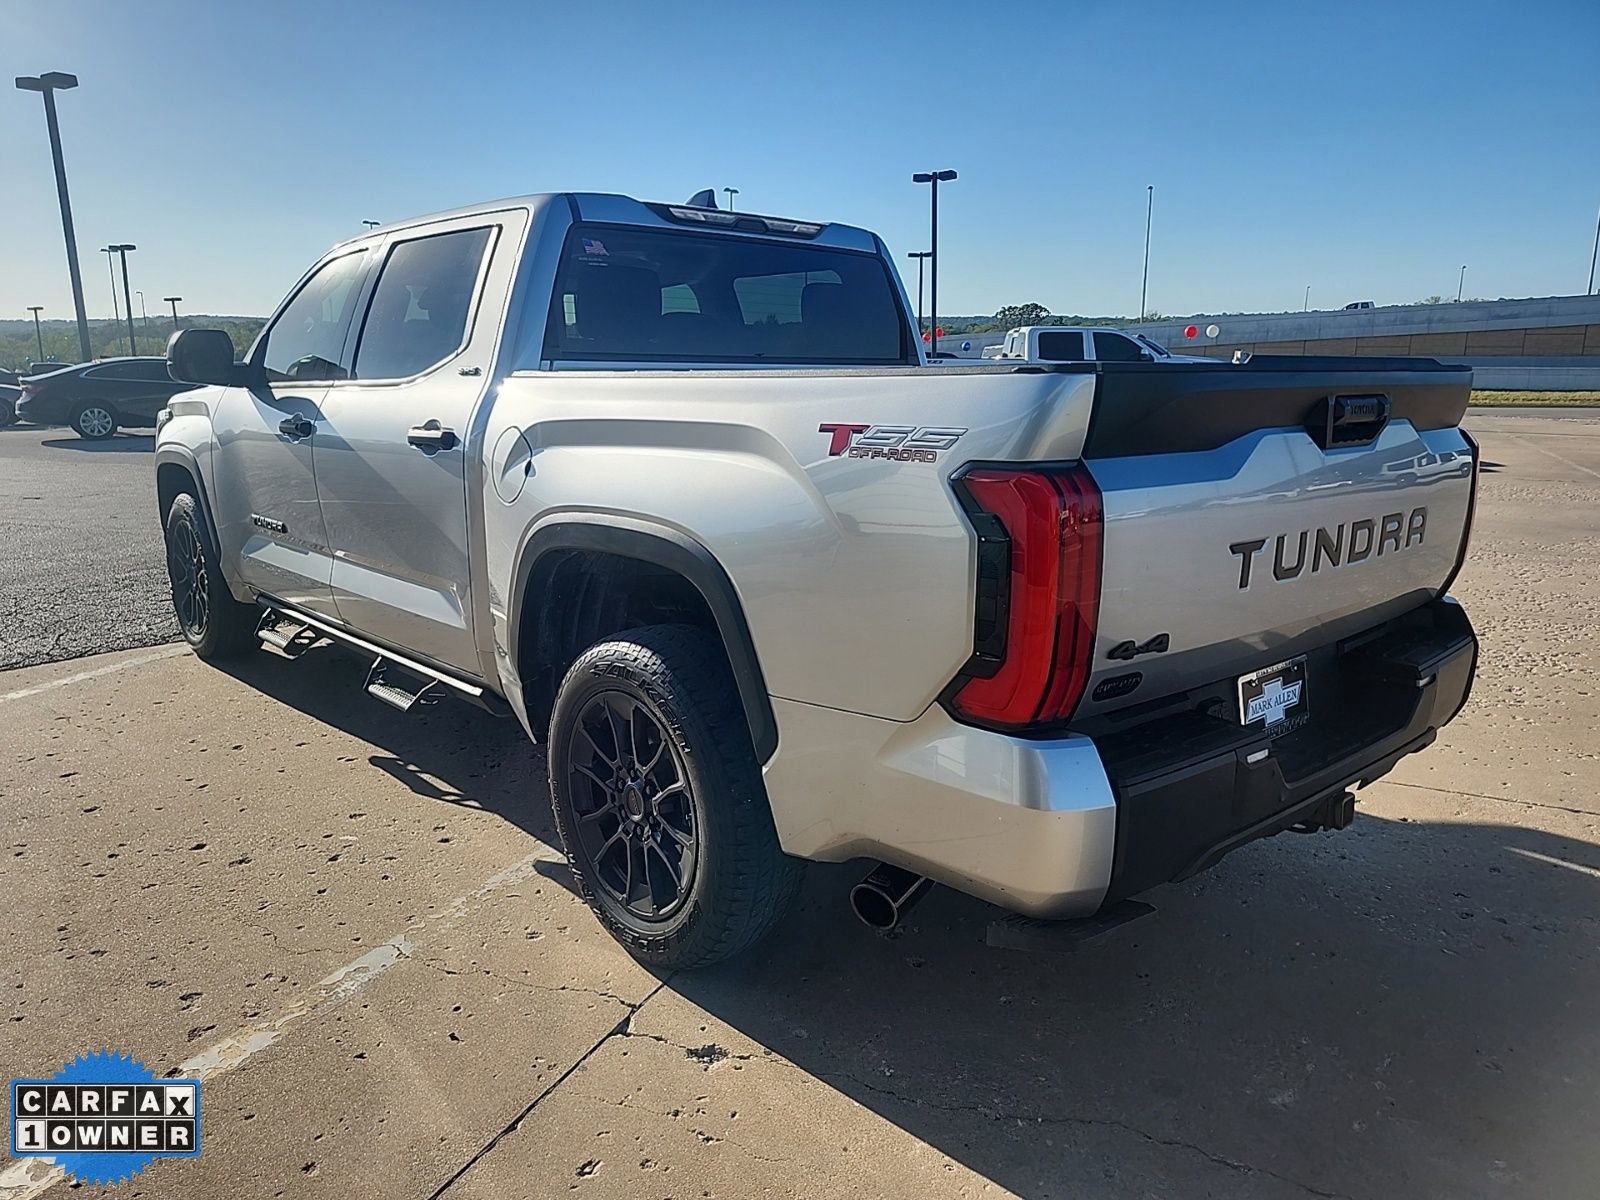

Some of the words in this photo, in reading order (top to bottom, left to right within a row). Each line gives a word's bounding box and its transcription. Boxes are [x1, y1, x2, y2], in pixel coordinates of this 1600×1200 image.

[849, 447, 938, 463] OFF-ROAD
[1229, 506, 1429, 590] TUNDRA
[1250, 697, 1273, 716] MARK
[1274, 688, 1298, 709] ALLEN
